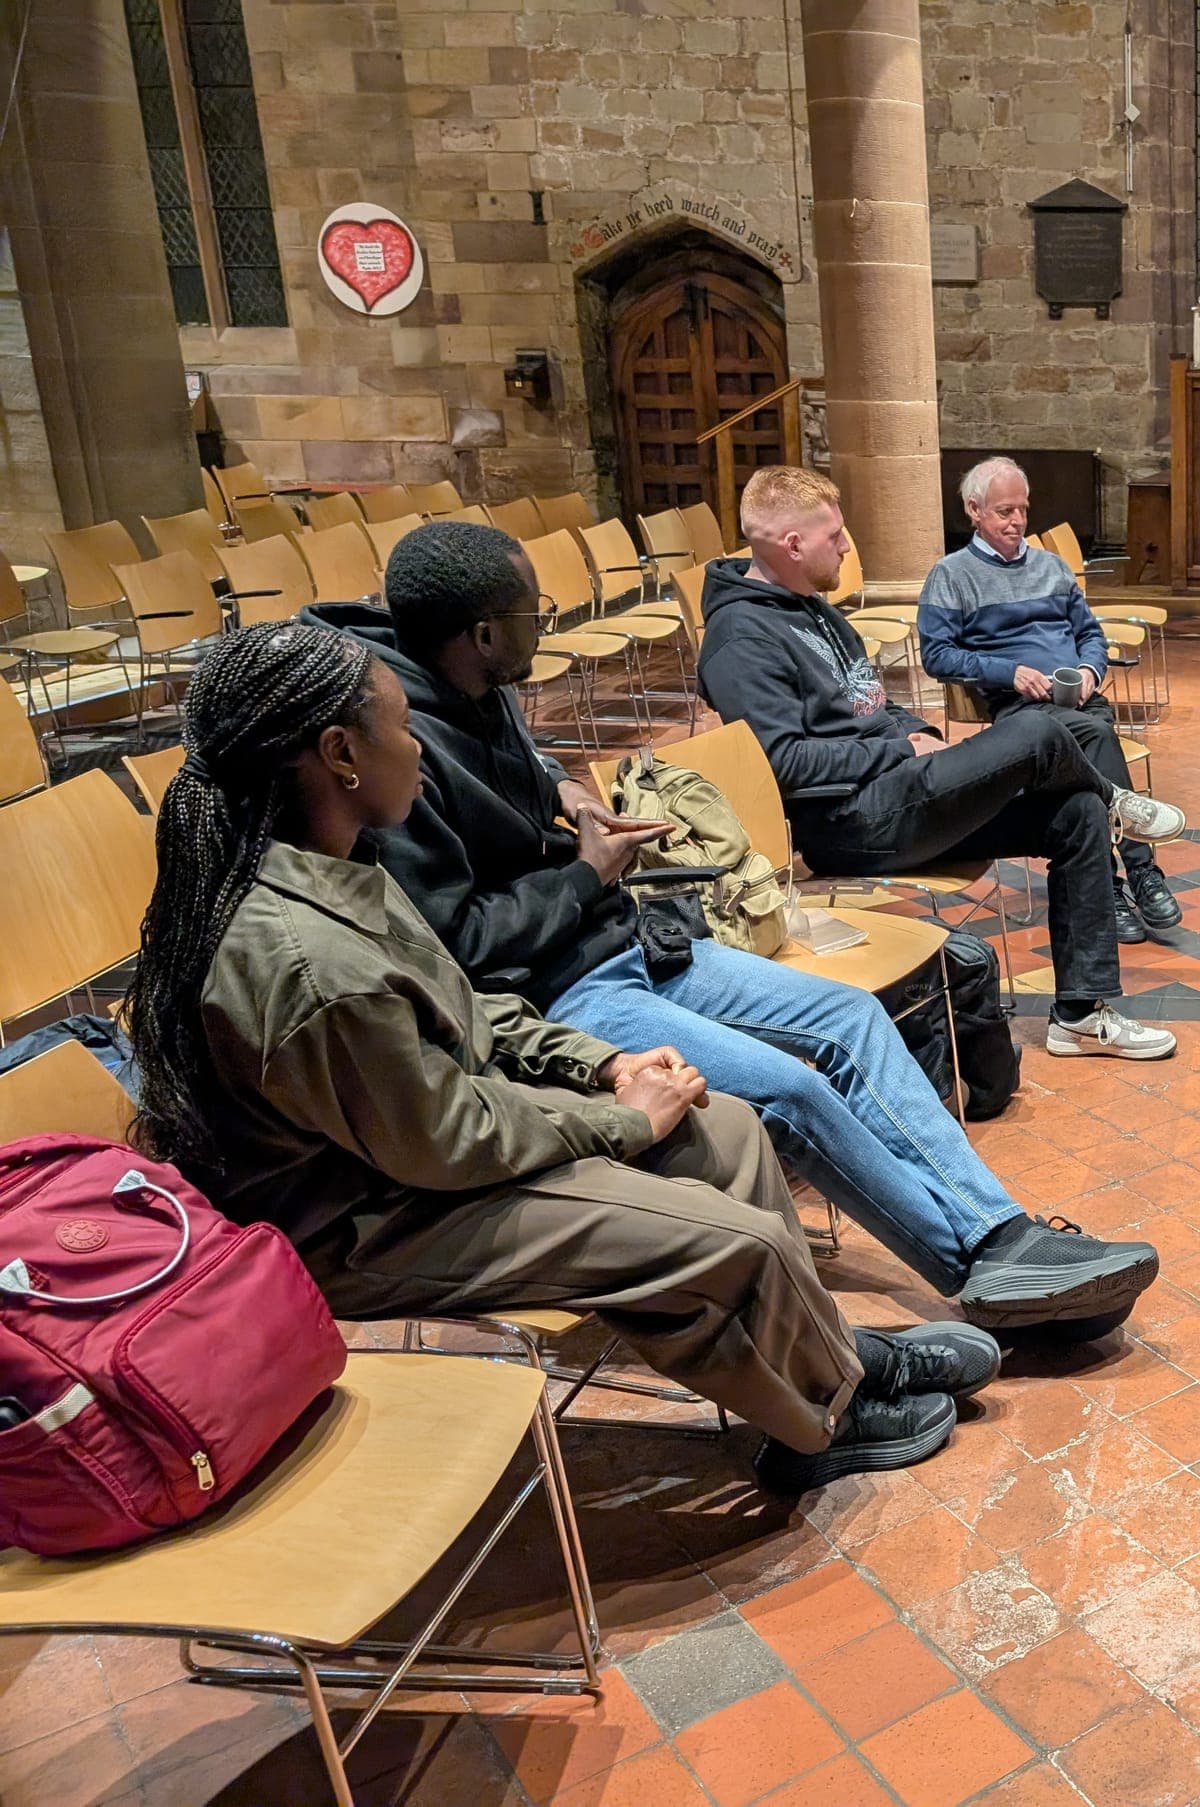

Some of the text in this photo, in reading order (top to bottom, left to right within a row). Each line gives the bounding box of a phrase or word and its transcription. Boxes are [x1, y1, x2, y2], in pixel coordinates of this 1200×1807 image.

[581, 194, 778, 261] Take ye heed watch and pray
